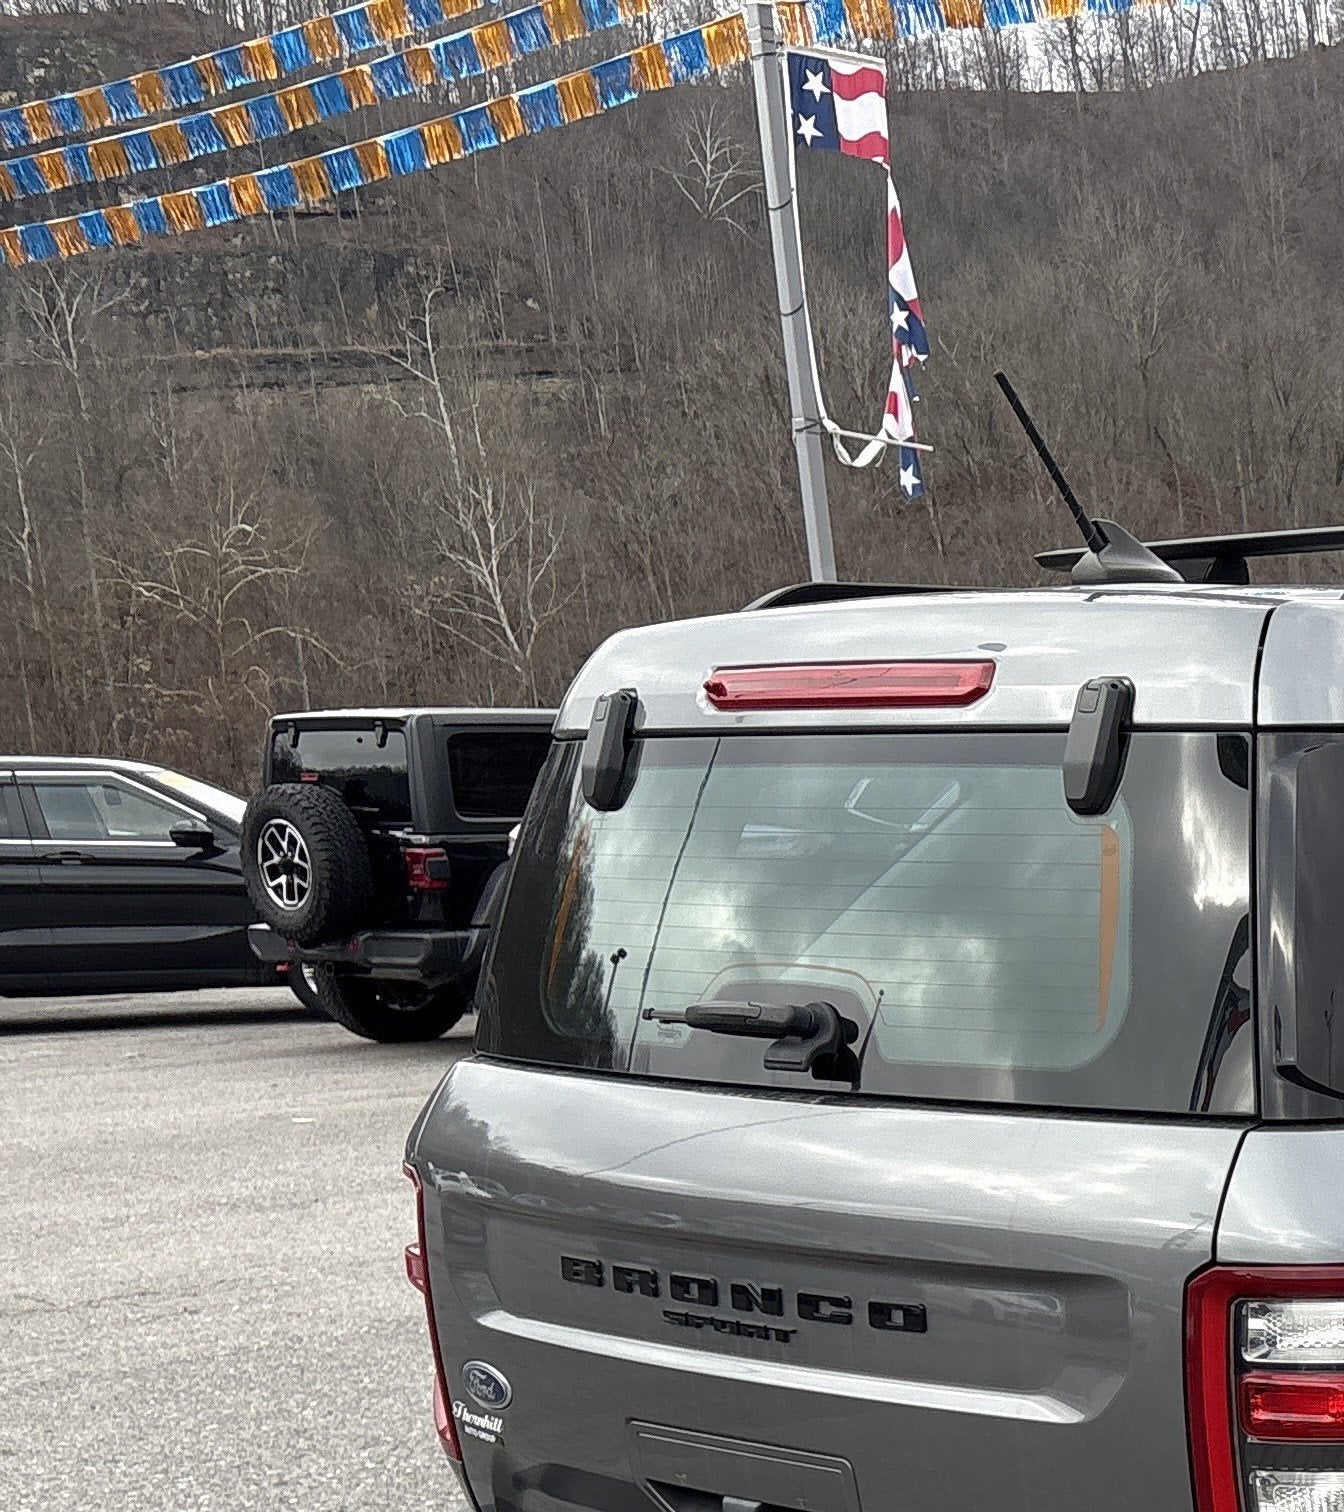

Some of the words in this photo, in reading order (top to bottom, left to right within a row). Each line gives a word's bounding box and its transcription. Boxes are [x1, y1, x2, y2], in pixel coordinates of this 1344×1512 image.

[560, 1255, 928, 1334] BRONCO
[661, 1309, 797, 1343] SPORT
[469, 1369, 497, 1400] Ford
[452, 1400, 504, 1433] Thornhill
